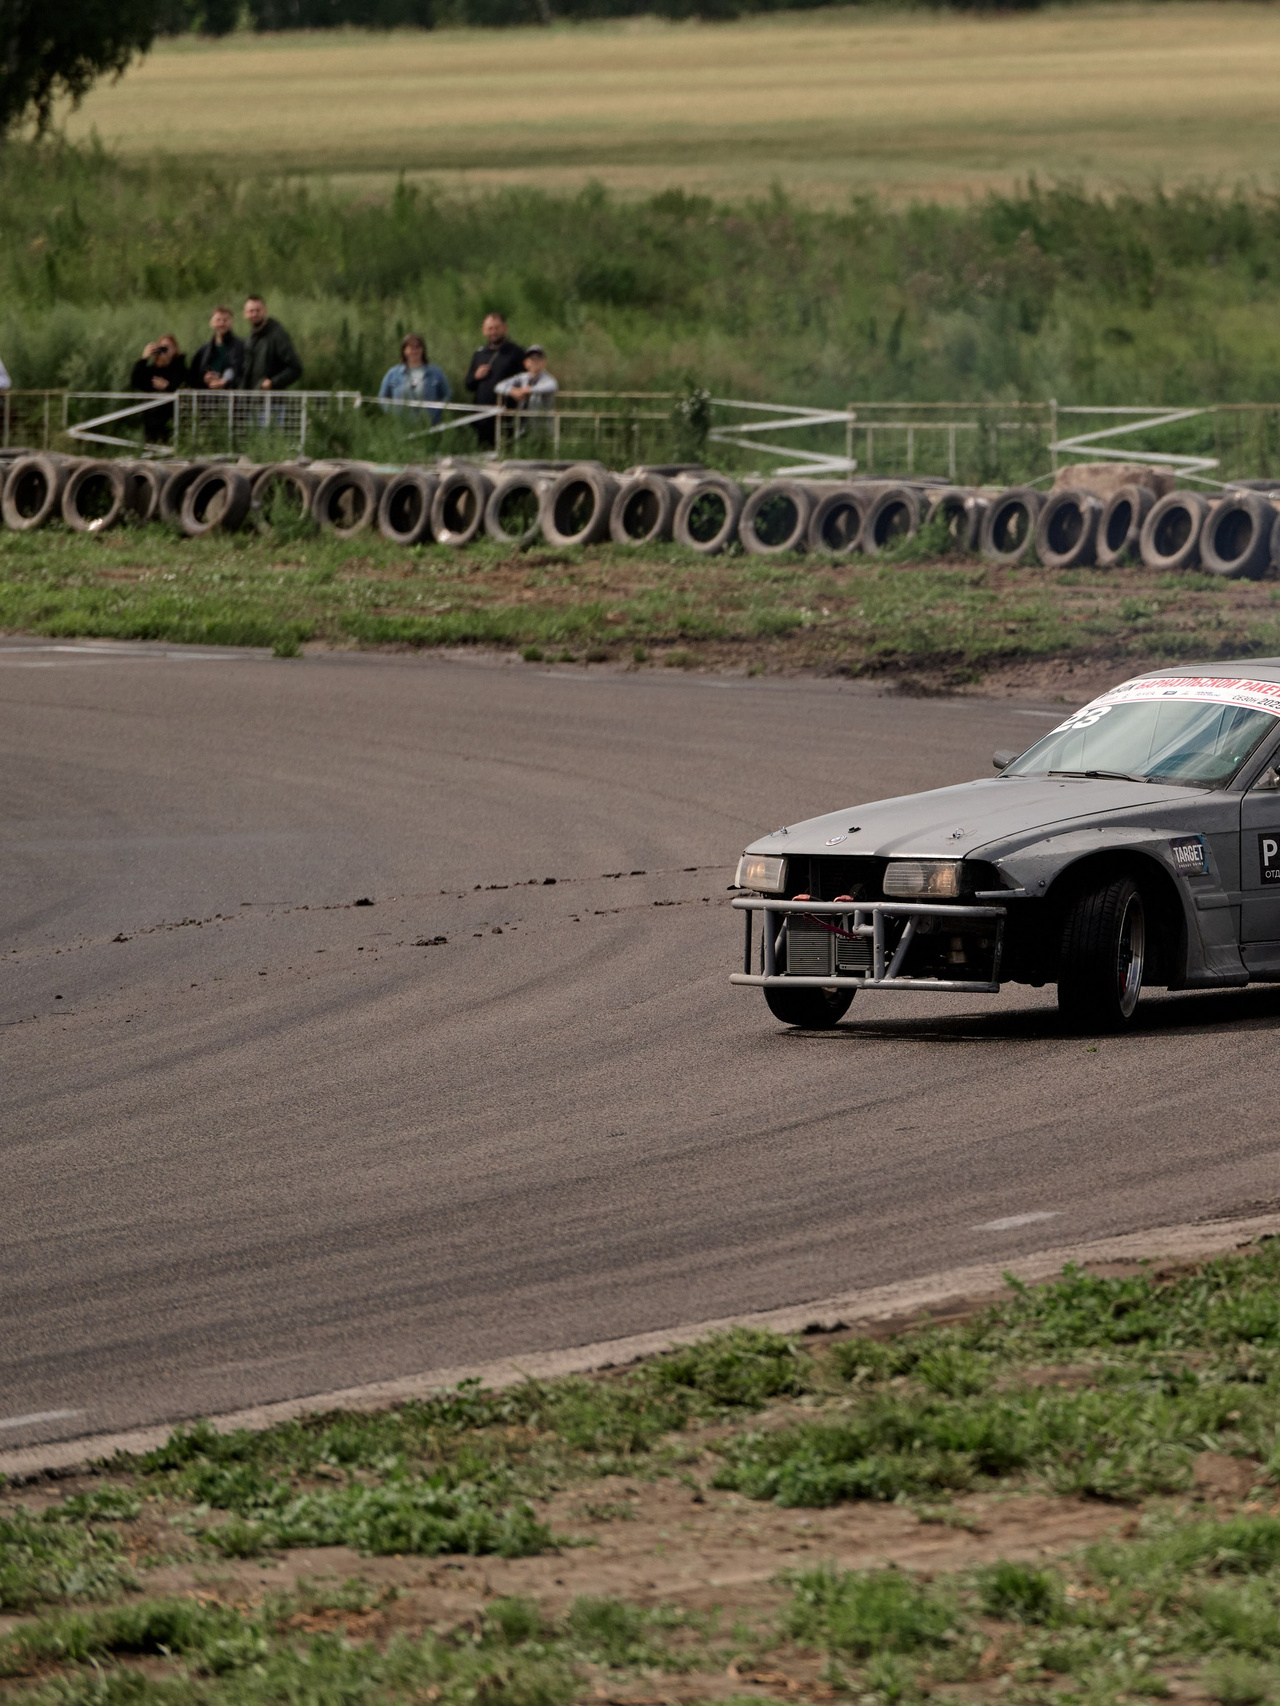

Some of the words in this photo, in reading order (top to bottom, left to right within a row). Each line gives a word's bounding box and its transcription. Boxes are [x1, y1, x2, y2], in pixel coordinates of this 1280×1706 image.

[1232, 694, 1257, 704] СЕЗОН
[1044, 705, 1113, 737] 23
[1173, 844, 1203, 863] TARGET
